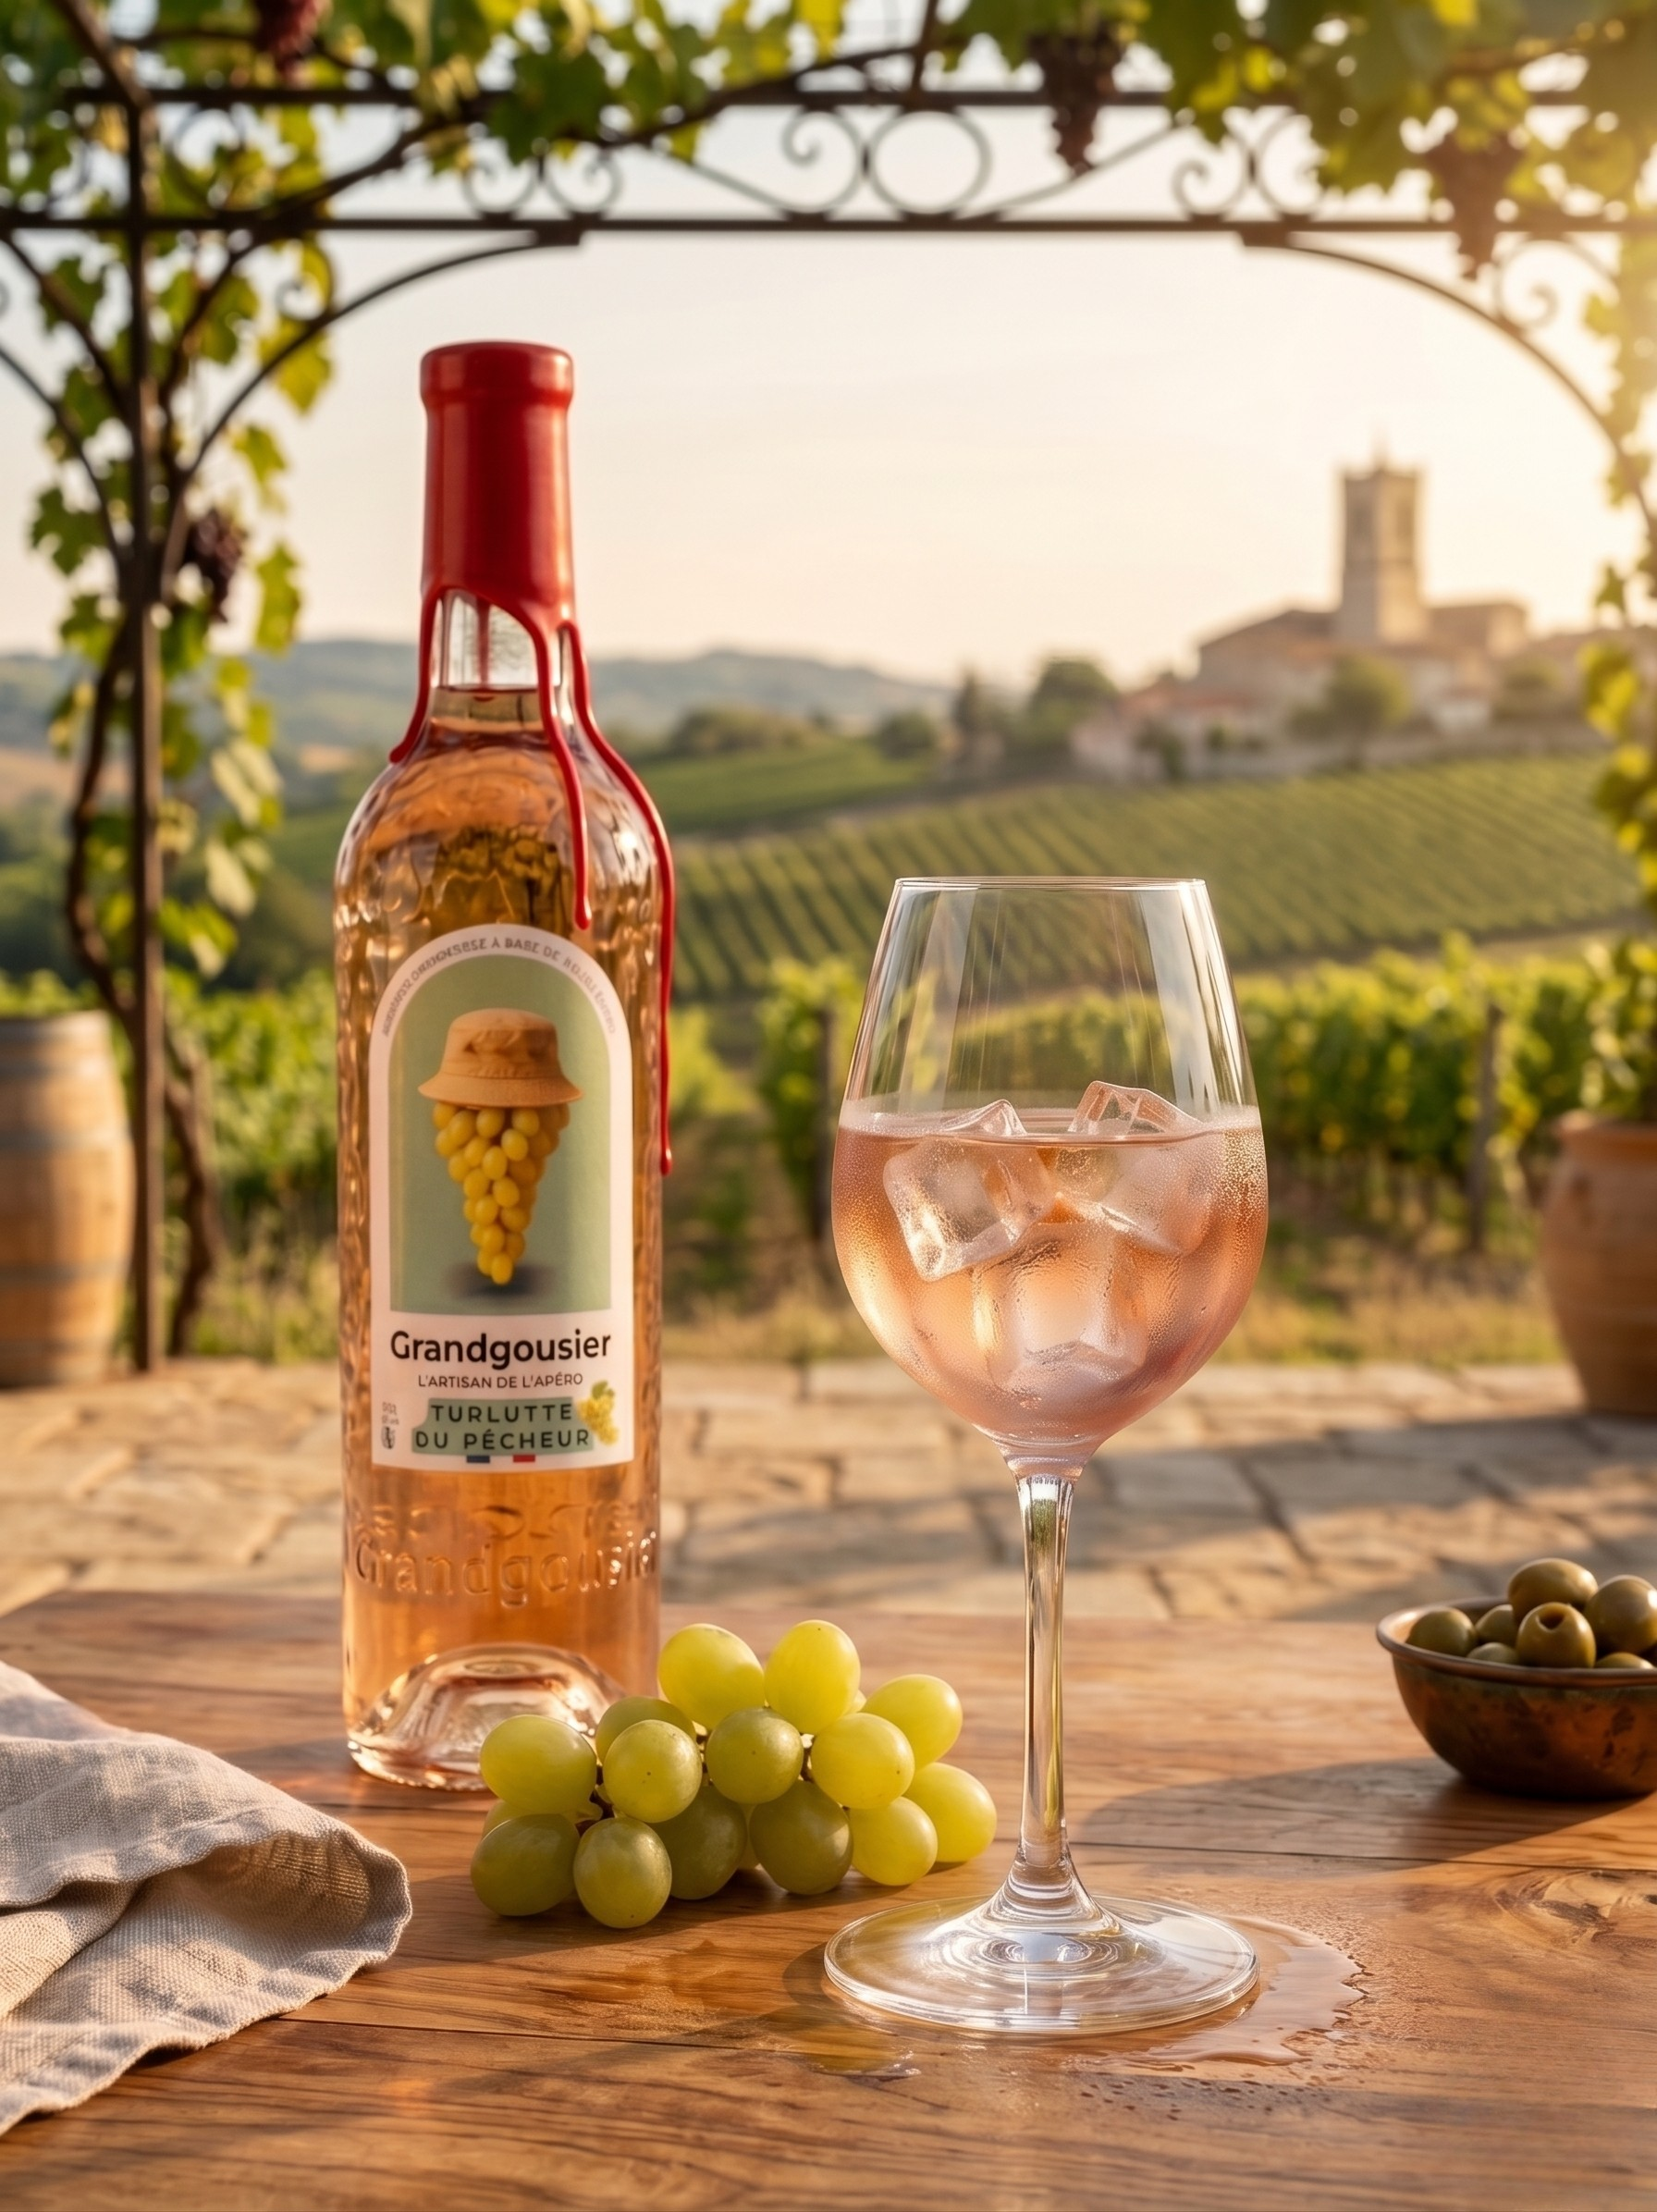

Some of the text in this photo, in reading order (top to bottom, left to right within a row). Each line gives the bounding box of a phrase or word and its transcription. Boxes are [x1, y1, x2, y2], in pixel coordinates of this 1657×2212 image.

[390, 1328, 611, 1370] Grandgousier
[418, 1371, 583, 1388] L'ARTISAN DE L'APÉRO
[431, 1403, 572, 1423] TURLUTTE
[415, 1429, 589, 1450] DU PÉCHEUR
